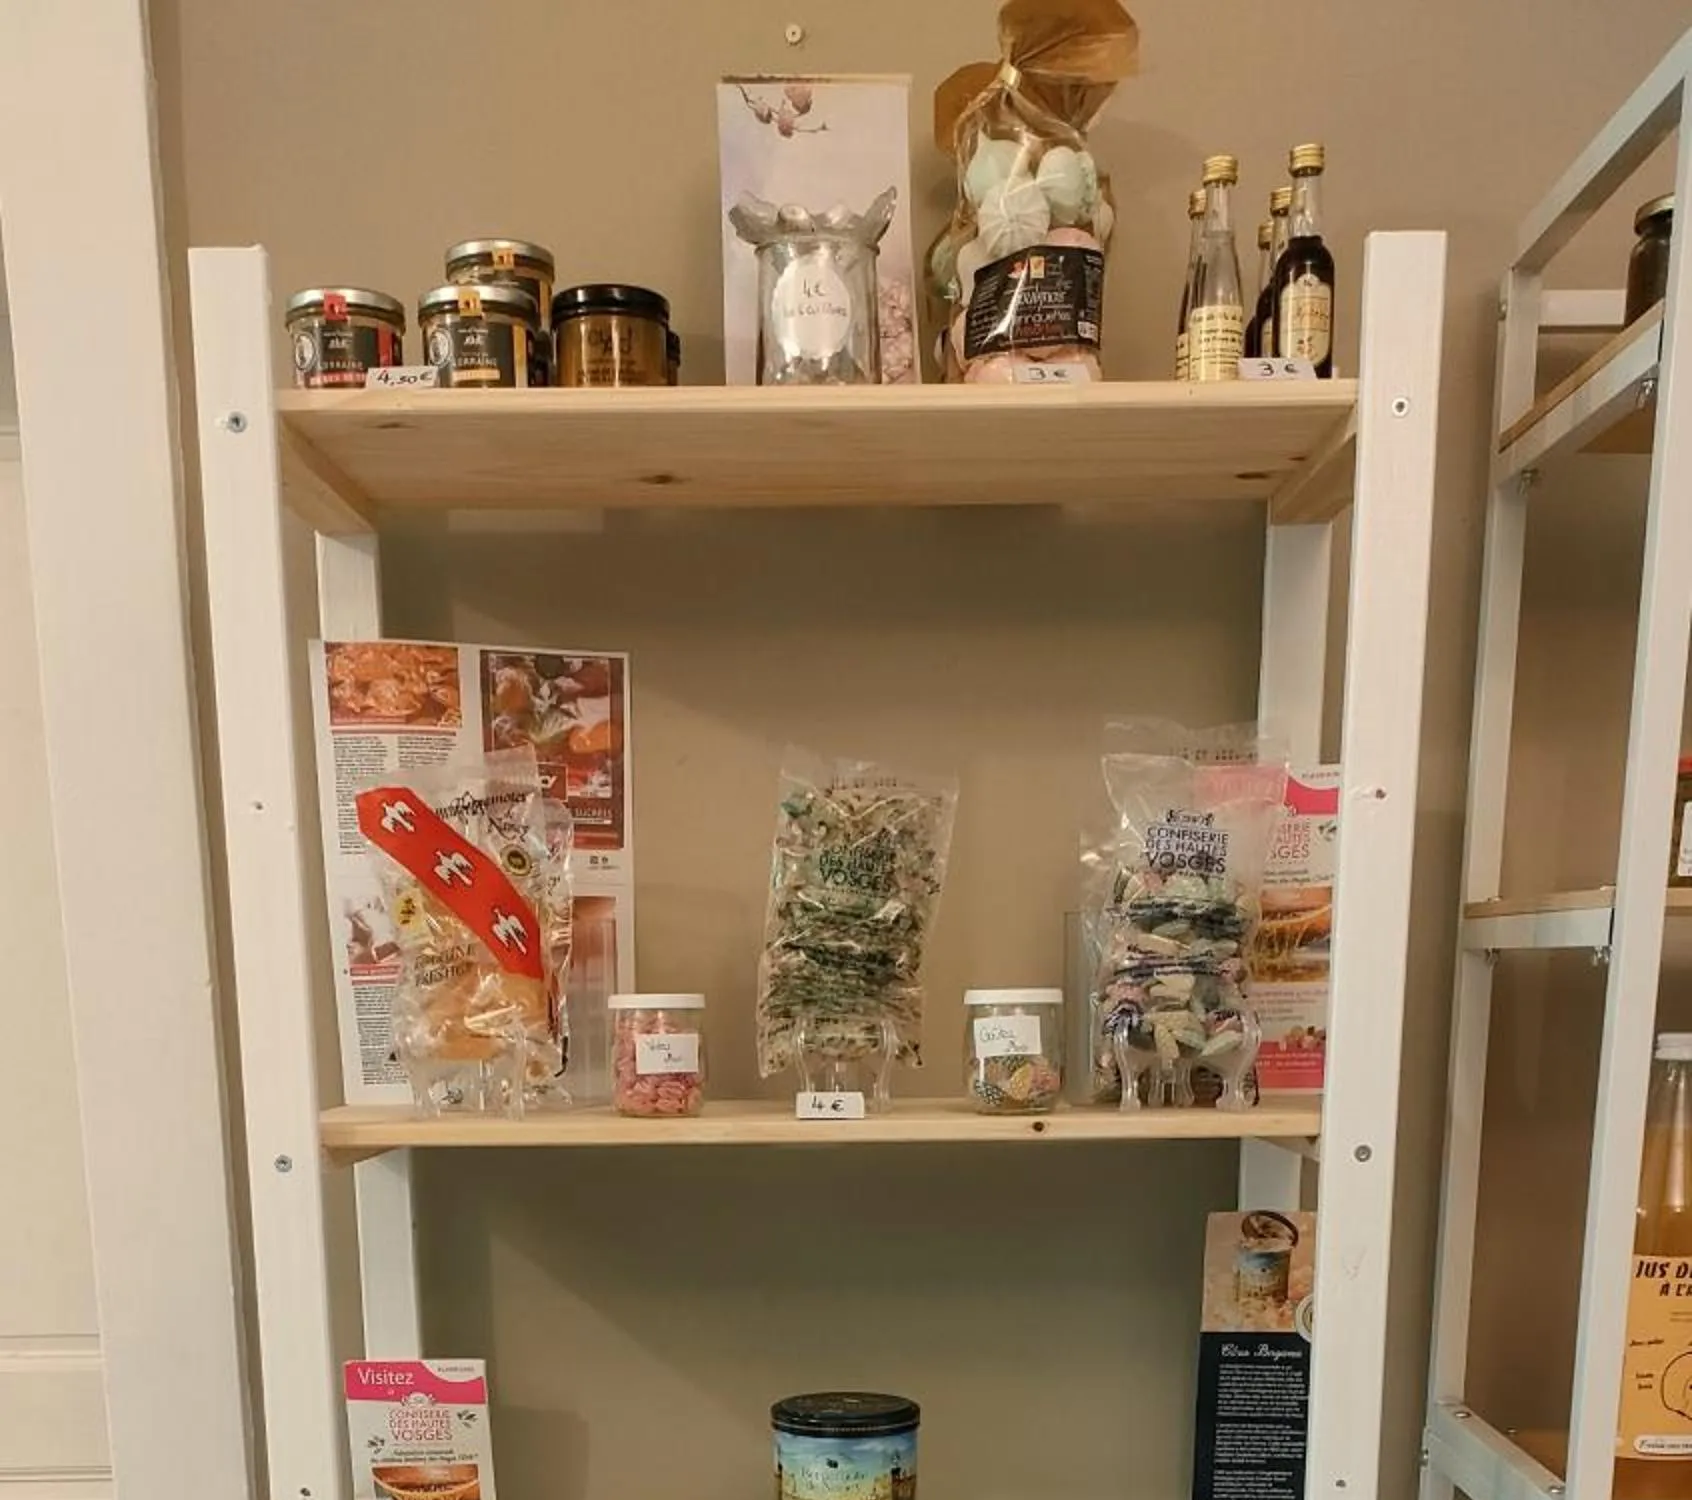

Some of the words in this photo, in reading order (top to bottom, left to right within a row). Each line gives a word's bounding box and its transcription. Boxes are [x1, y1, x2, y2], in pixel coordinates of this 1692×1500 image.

[1145, 851, 1226, 874] VOSGES
[1635, 1260, 1671, 1278] JUS
[357, 1368, 415, 1386] Visitez
[391, 1428, 454, 1442] VOSGES
